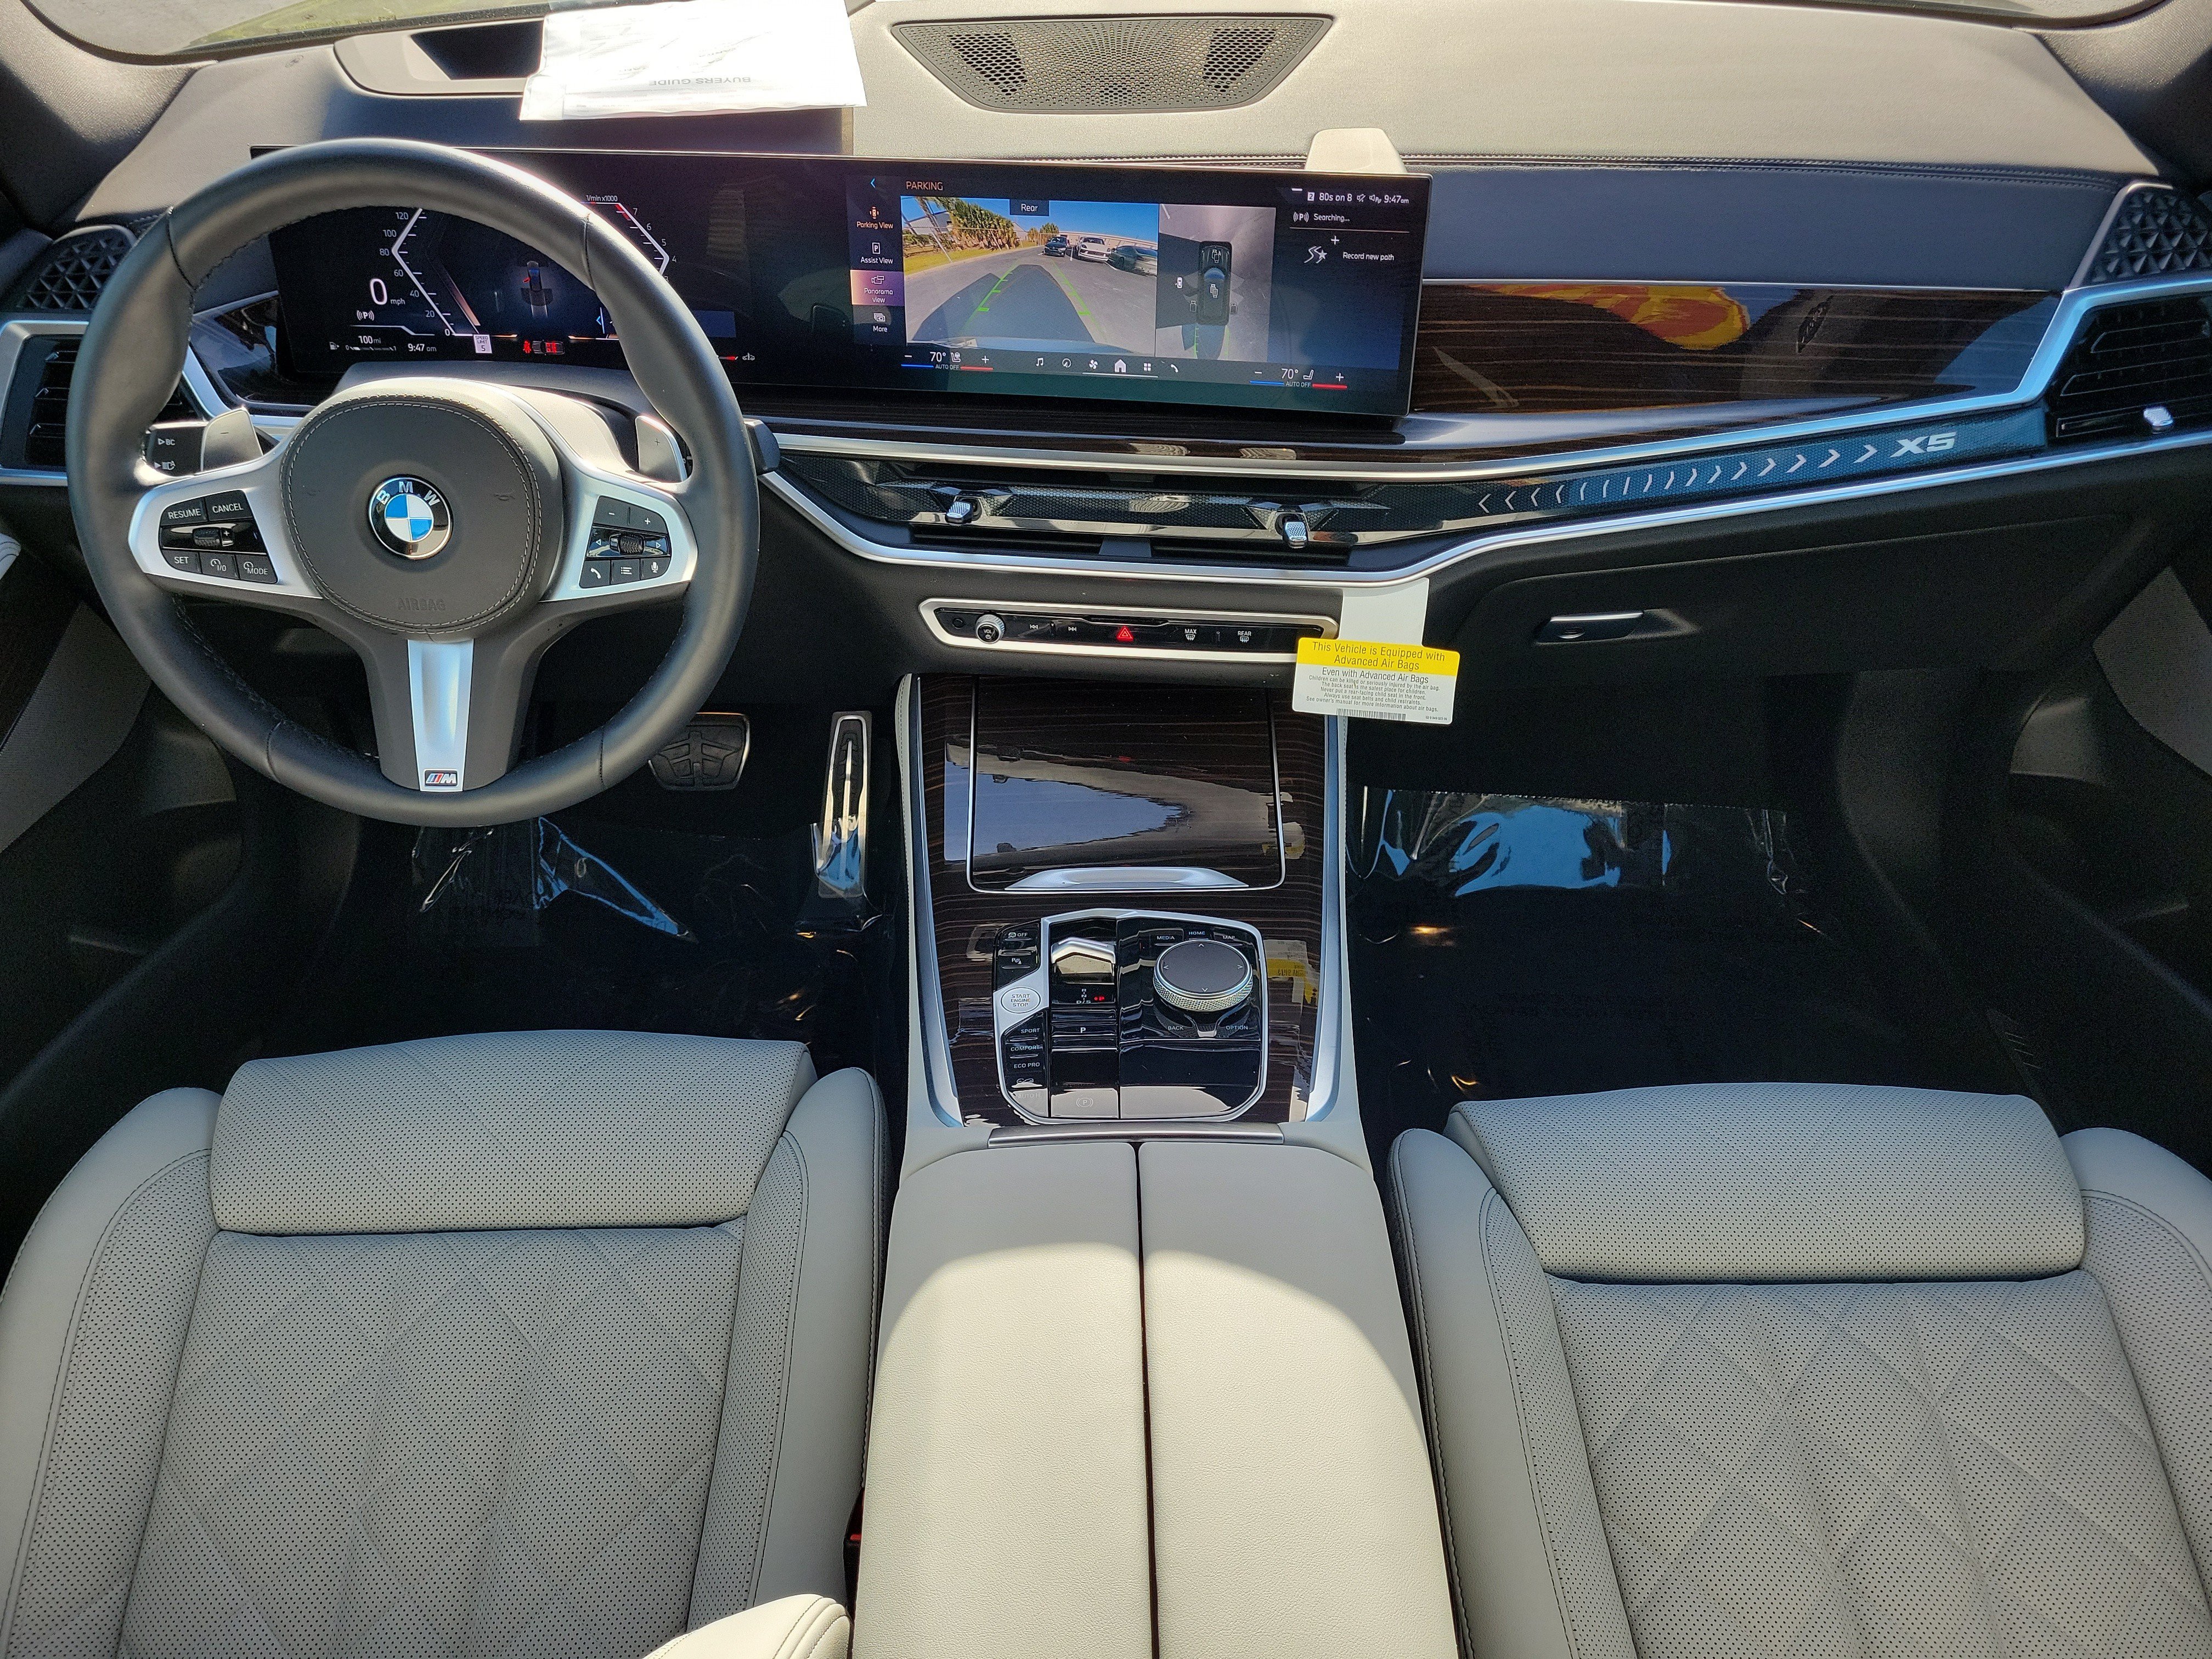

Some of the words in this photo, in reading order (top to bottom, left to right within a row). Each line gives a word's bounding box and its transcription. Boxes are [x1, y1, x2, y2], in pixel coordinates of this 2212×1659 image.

[906, 181, 943, 191] PARKING
[1319, 193, 1333, 201] 80s
[1021, 203, 1038, 212] Rear
[1313, 213, 1350, 222] Searching...
[856, 222, 878, 230] Parking
[1342, 252, 1364, 260] Record
[370, 278, 388, 305] 0
[358, 336, 373, 345] 100
[408, 343, 425, 352] 9:47
[929, 352, 946, 362] 70°
[1281, 368, 1299, 379] 70°
[1889, 432, 1957, 458] X5
[212, 503, 244, 514] CANCEL
[168, 509, 201, 520] RESUME
[397, 597, 447, 611] AIRBAG
[1313, 641, 1331, 651] This
[1335, 642, 1367, 654] Vehicle
[1370, 646, 1377, 655] is
[1380, 647, 1423, 659] Equipped
[1426, 652, 1445, 662] with
[1334, 654, 1379, 667] Advanced
[1381, 658, 1394, 668] Air
[1397, 659, 1419, 672] Bags
[1322, 667, 1340, 676] Even
[1342, 669, 1357, 678] with
[1359, 670, 1396, 681] Advanced
[1397, 673, 1408, 681] Air
[1410, 674, 1429, 685] Bags
